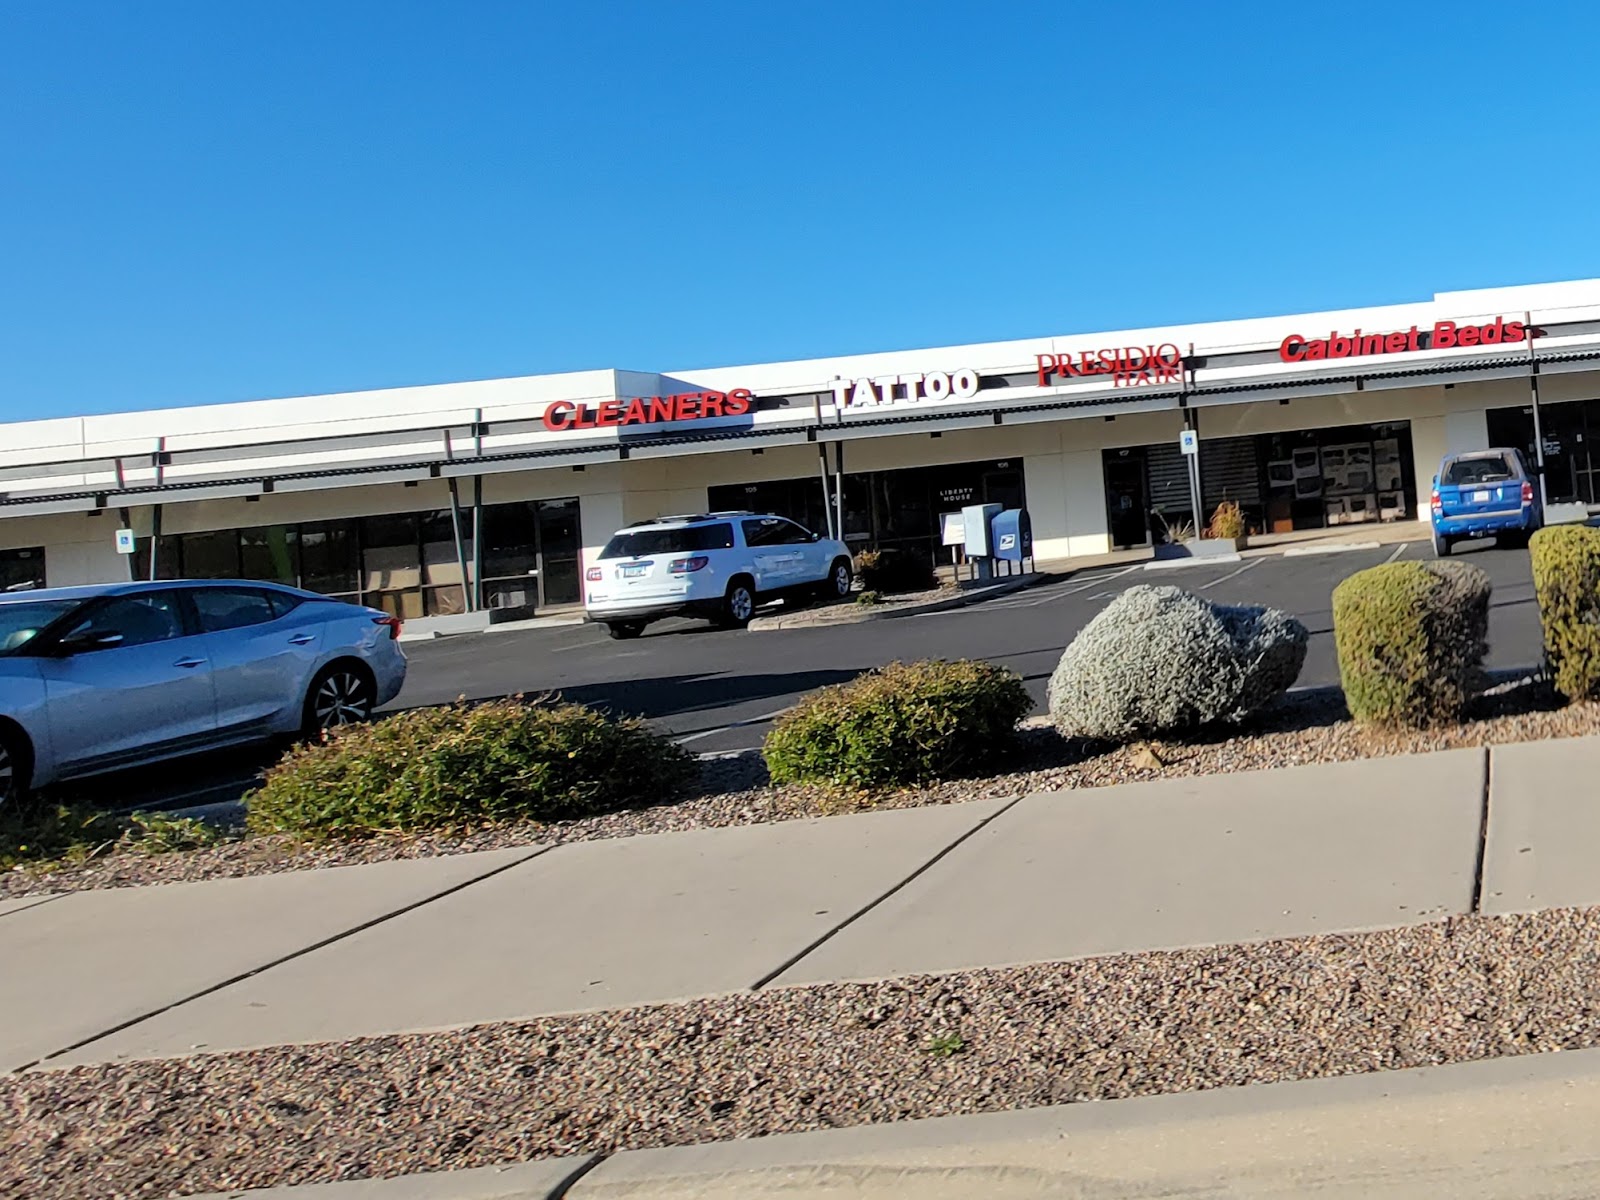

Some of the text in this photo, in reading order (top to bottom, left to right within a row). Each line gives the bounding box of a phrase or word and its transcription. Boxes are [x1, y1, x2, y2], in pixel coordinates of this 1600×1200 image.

[1279, 316, 1526, 363] Cabinet Beds
[1035, 343, 1181, 388] PRESIDIO
[1113, 368, 1182, 387] HAIR
[828, 368, 979, 409] TATTOO
[541, 388, 753, 431] CLEANERS
[939, 487, 974, 496] LIBERTY
[943, 493, 971, 502] HOUSE
